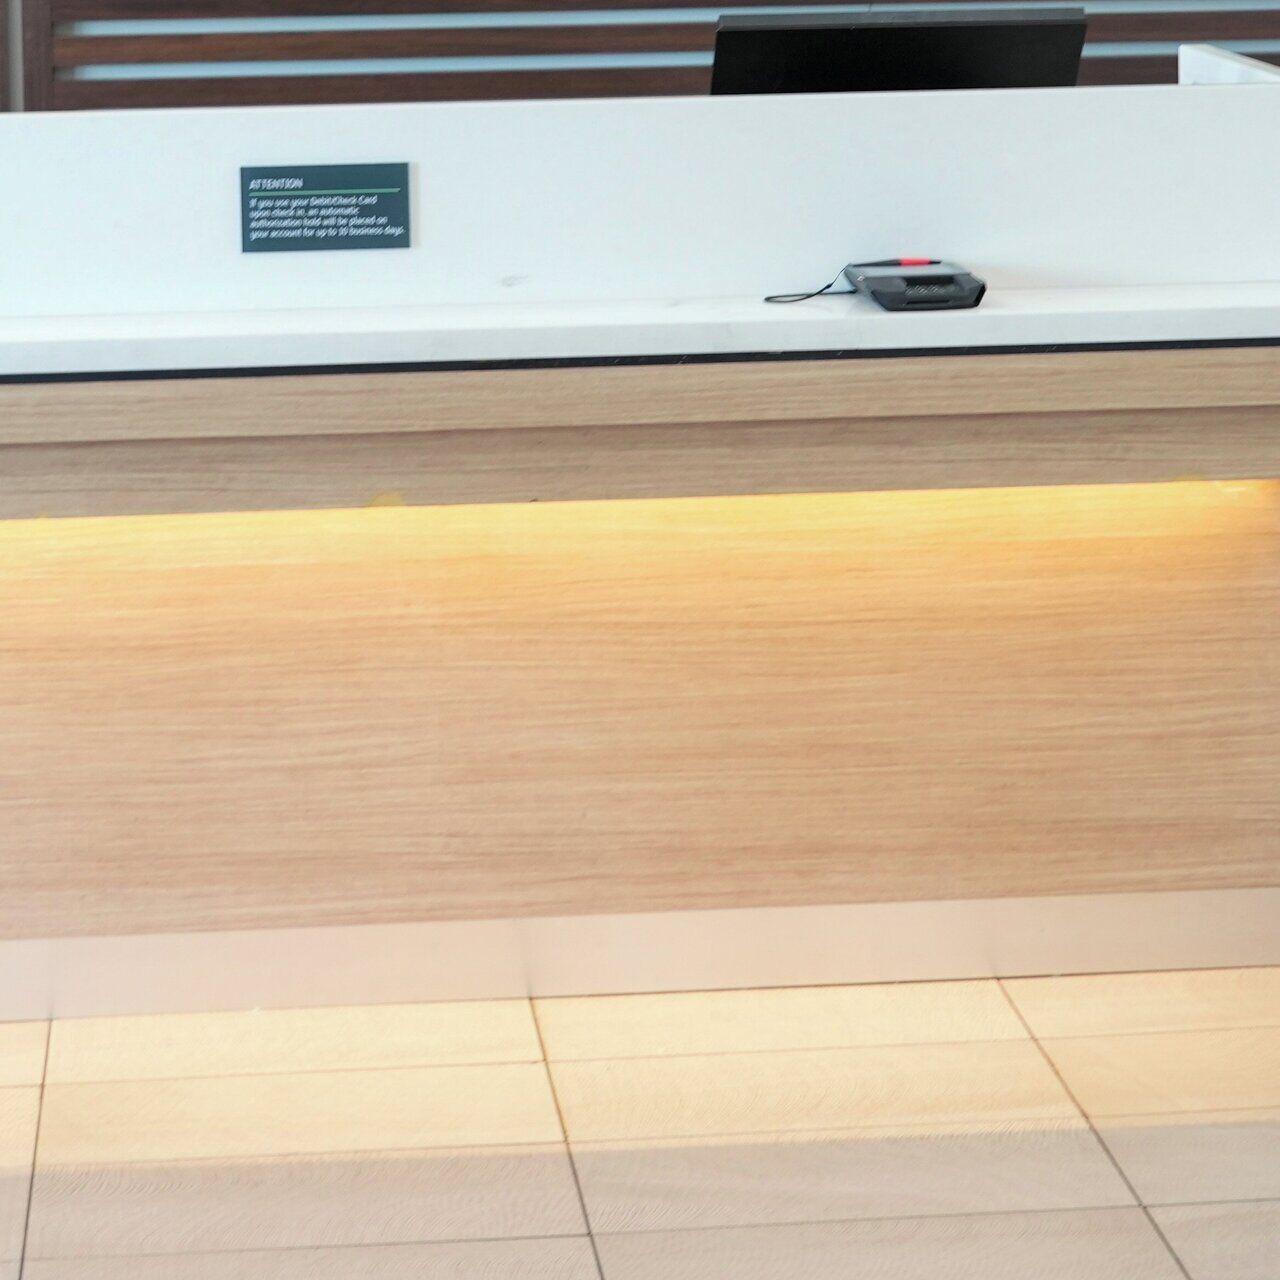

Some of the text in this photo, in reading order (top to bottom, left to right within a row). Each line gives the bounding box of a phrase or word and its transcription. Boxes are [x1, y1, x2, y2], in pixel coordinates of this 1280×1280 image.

[249, 177, 304, 190] ATTENTION
[258, 199, 275, 211] you
[274, 199, 291, 208] use
[290, 198, 310, 210] your
[271, 207, 295, 218] check
[307, 208, 320, 217] an
[319, 206, 360, 216] automatic
[302, 217, 322, 227] hold
[322, 216, 337, 226] will
[337, 216, 348, 226] be
[348, 215, 376, 227] placed
[375, 216, 389, 225] on
[249, 230, 269, 242] your
[269, 228, 303, 238] account
[302, 227, 316, 237] for
[315, 228, 328, 239] up
[327, 227, 338, 237] to
[348, 226, 384, 236] business
